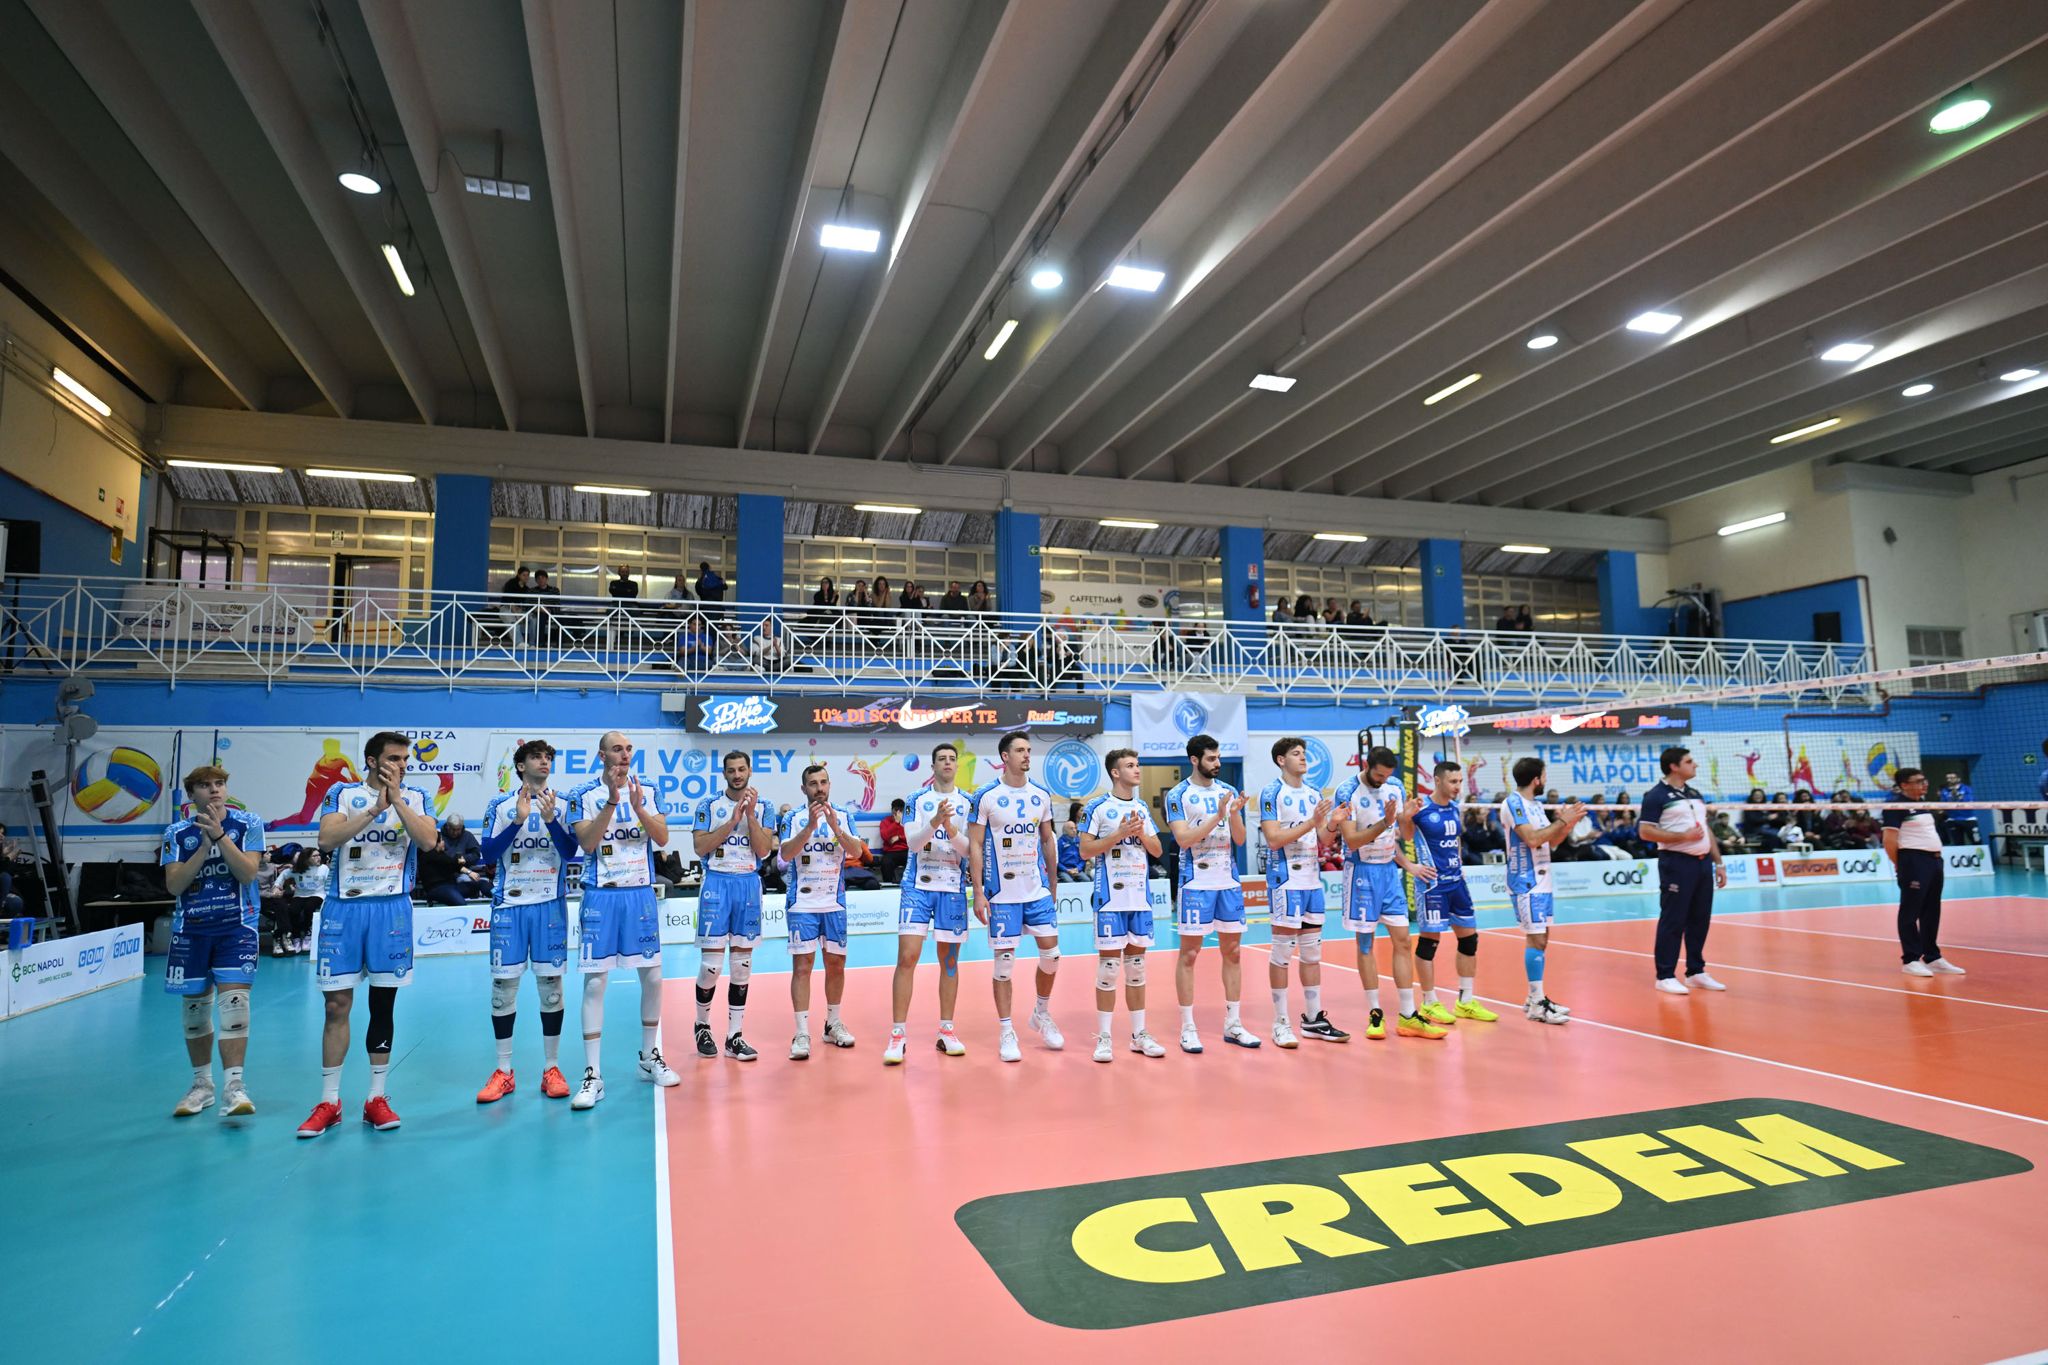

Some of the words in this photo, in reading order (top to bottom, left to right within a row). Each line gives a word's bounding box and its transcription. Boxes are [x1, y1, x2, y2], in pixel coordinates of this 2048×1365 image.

[813, 708, 843, 723] 10%
[847, 708, 866, 723] DI
[869, 708, 937, 724] SCONTO
[941, 709, 973, 724] PER
[976, 710, 998, 724] TE
[1143, 742, 1185, 751] FORZA
[1403, 728, 1414, 768] BANCA
[1533, 744, 1600, 764] TEAM
[1603, 743, 1686, 763] VOLL
[418, 762, 449, 772] Over
[658, 749, 796, 774] VOLEY
[1573, 763, 1655, 785] NAPOLI
[616, 801, 632, 823] 11
[667, 802, 690, 814] 016
[1016, 798, 1026, 818] 2
[1203, 797, 1218, 814] 13
[1299, 799, 1307, 816] 4
[527, 812, 541, 833] 8
[1443, 820, 1457, 836] 10
[666, 912, 690, 927] tea
[760, 908, 785, 923] oup
[847, 910, 890, 920] ognamiglio
[1185, 909, 1201, 926] 13
[1427, 909, 1441, 924] 10
[703, 921, 713, 940] 7
[22, 963, 37, 976] BCC
[37, 957, 65, 972] NAPOLI
[167, 965, 185, 985] 18
[319, 957, 331, 981] 6
[1069, 1113, 1906, 1285] CREDEM
